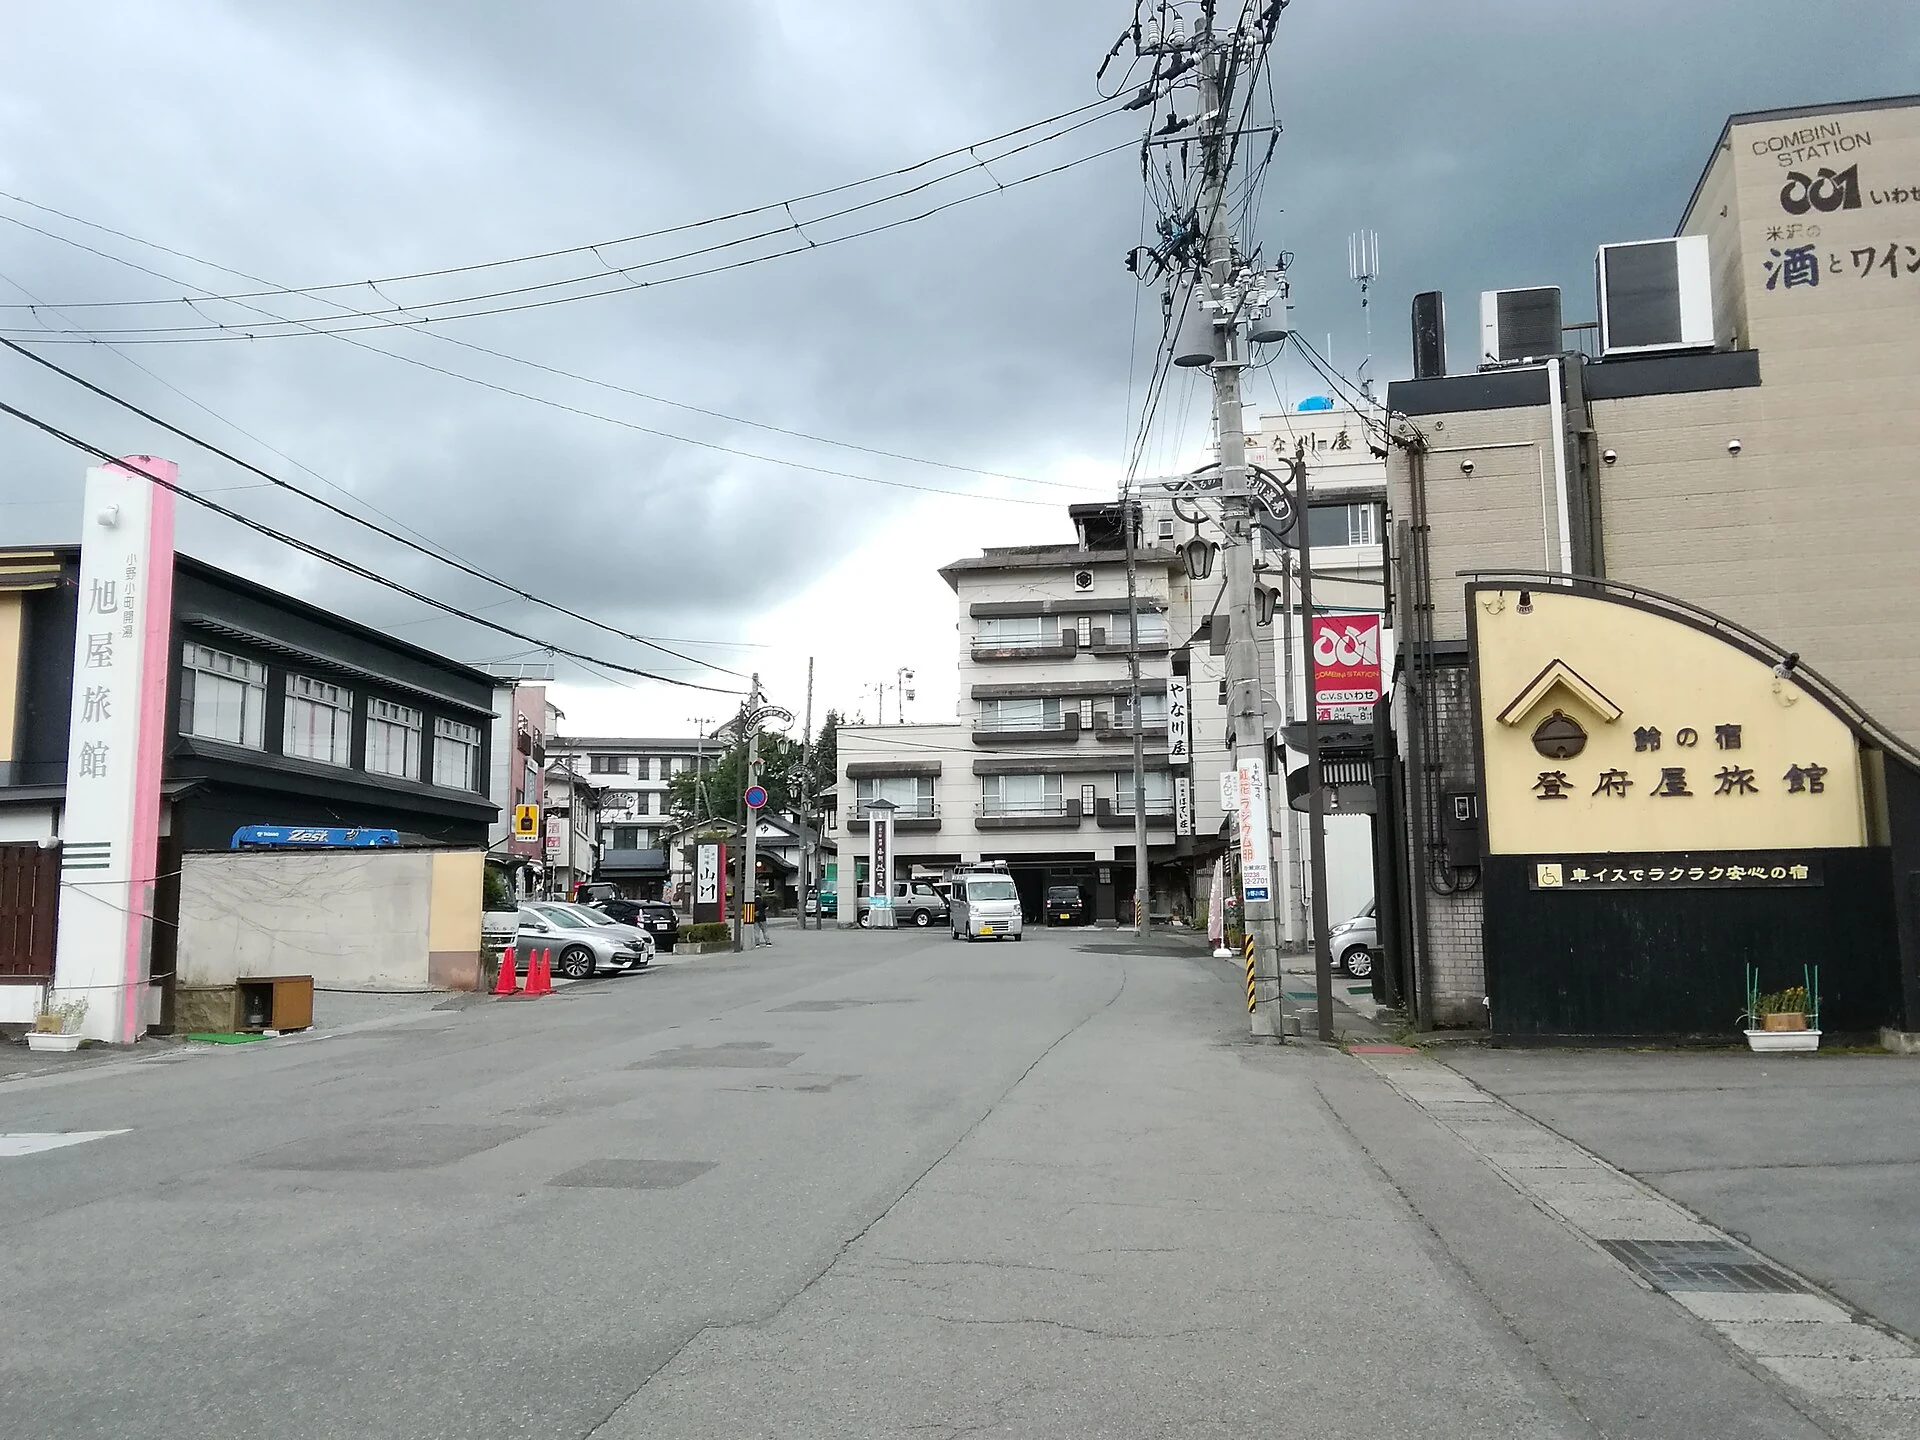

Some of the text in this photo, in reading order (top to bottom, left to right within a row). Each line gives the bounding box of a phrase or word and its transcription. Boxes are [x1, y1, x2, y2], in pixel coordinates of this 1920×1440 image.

[1752, 121, 1842, 156] COMBINI
[1777, 131, 1872, 168] STATION
[1766, 223, 1821, 242] 米沢の
[78, 577, 118, 779] 旭屋旅館
[1345, 670, 1379, 679] STATION
[1169, 683, 1187, 756] やな川屋
[1633, 723, 1744, 752] 鈴の宿
[1531, 762, 1829, 800] 登府屋旅館
[287, 829, 329, 842] Zest
[760, 824, 769, 834] ゆ
[1569, 863, 1810, 883] 車イスでラクラク安心の宿
